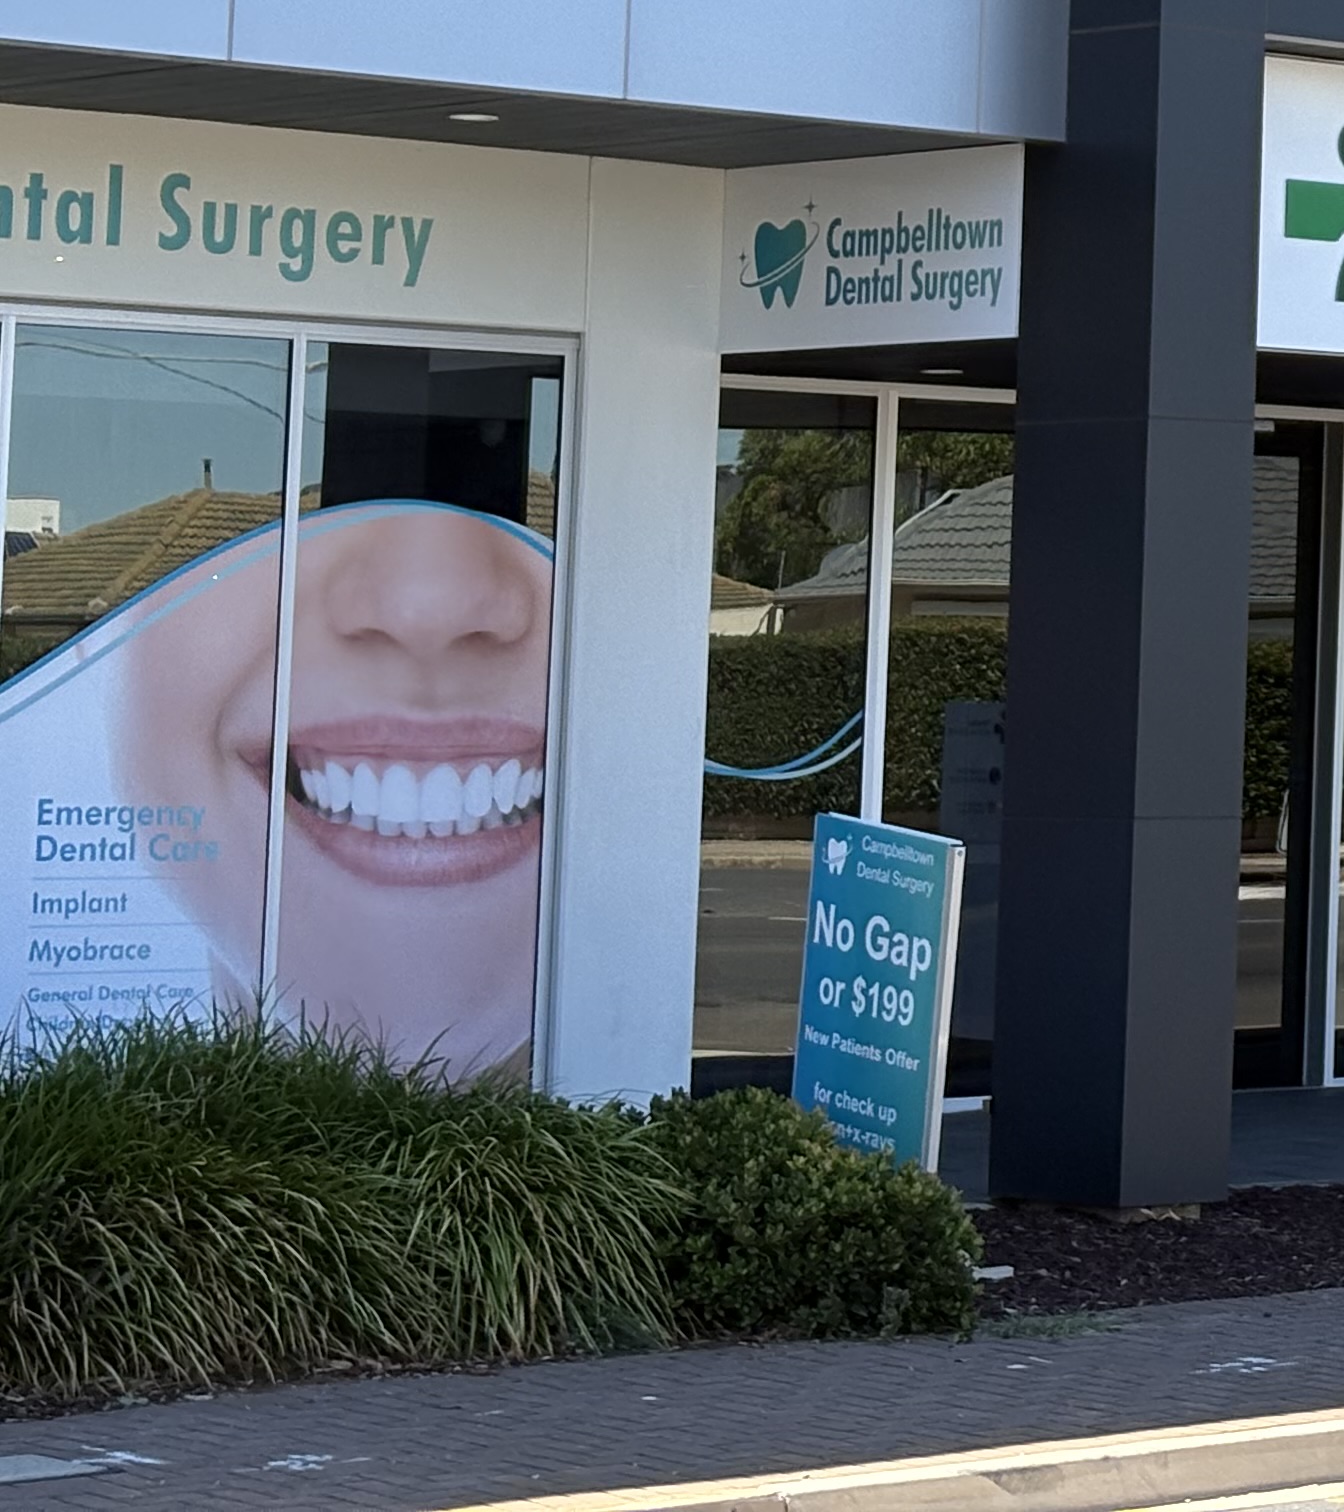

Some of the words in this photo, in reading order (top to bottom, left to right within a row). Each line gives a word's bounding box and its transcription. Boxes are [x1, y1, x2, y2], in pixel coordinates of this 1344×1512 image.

[158, 172, 434, 287] Surgery
[826, 207, 1003, 265] Campbelltown
[825, 258, 903, 306] Dental
[910, 259, 1003, 311] Surgery
[37, 798, 207, 833] Emergency
[35, 833, 136, 862] Dental
[149, 834, 220, 863] Care
[862, 835, 935, 866] Campbelltown
[856, 861, 891, 884] Dental
[891, 870, 935, 899] Surgery
[32, 890, 128, 919] Implant
[28, 937, 152, 968] Myobrace
[813, 899, 855, 953] No
[865, 914, 932, 981] Gap
[28, 985, 93, 1003] General
[98, 985, 151, 1001] Dental
[157, 984, 194, 999] Care
[819, 976, 846, 1008] or
[851, 974, 915, 1027] $199
[804, 1024, 829, 1048] New
[832, 1032, 882, 1063] Patients
[885, 1047, 920, 1072] Offer
[814, 1081, 833, 1104] for
[835, 1090, 875, 1118] check
[878, 1105, 898, 1127] up
